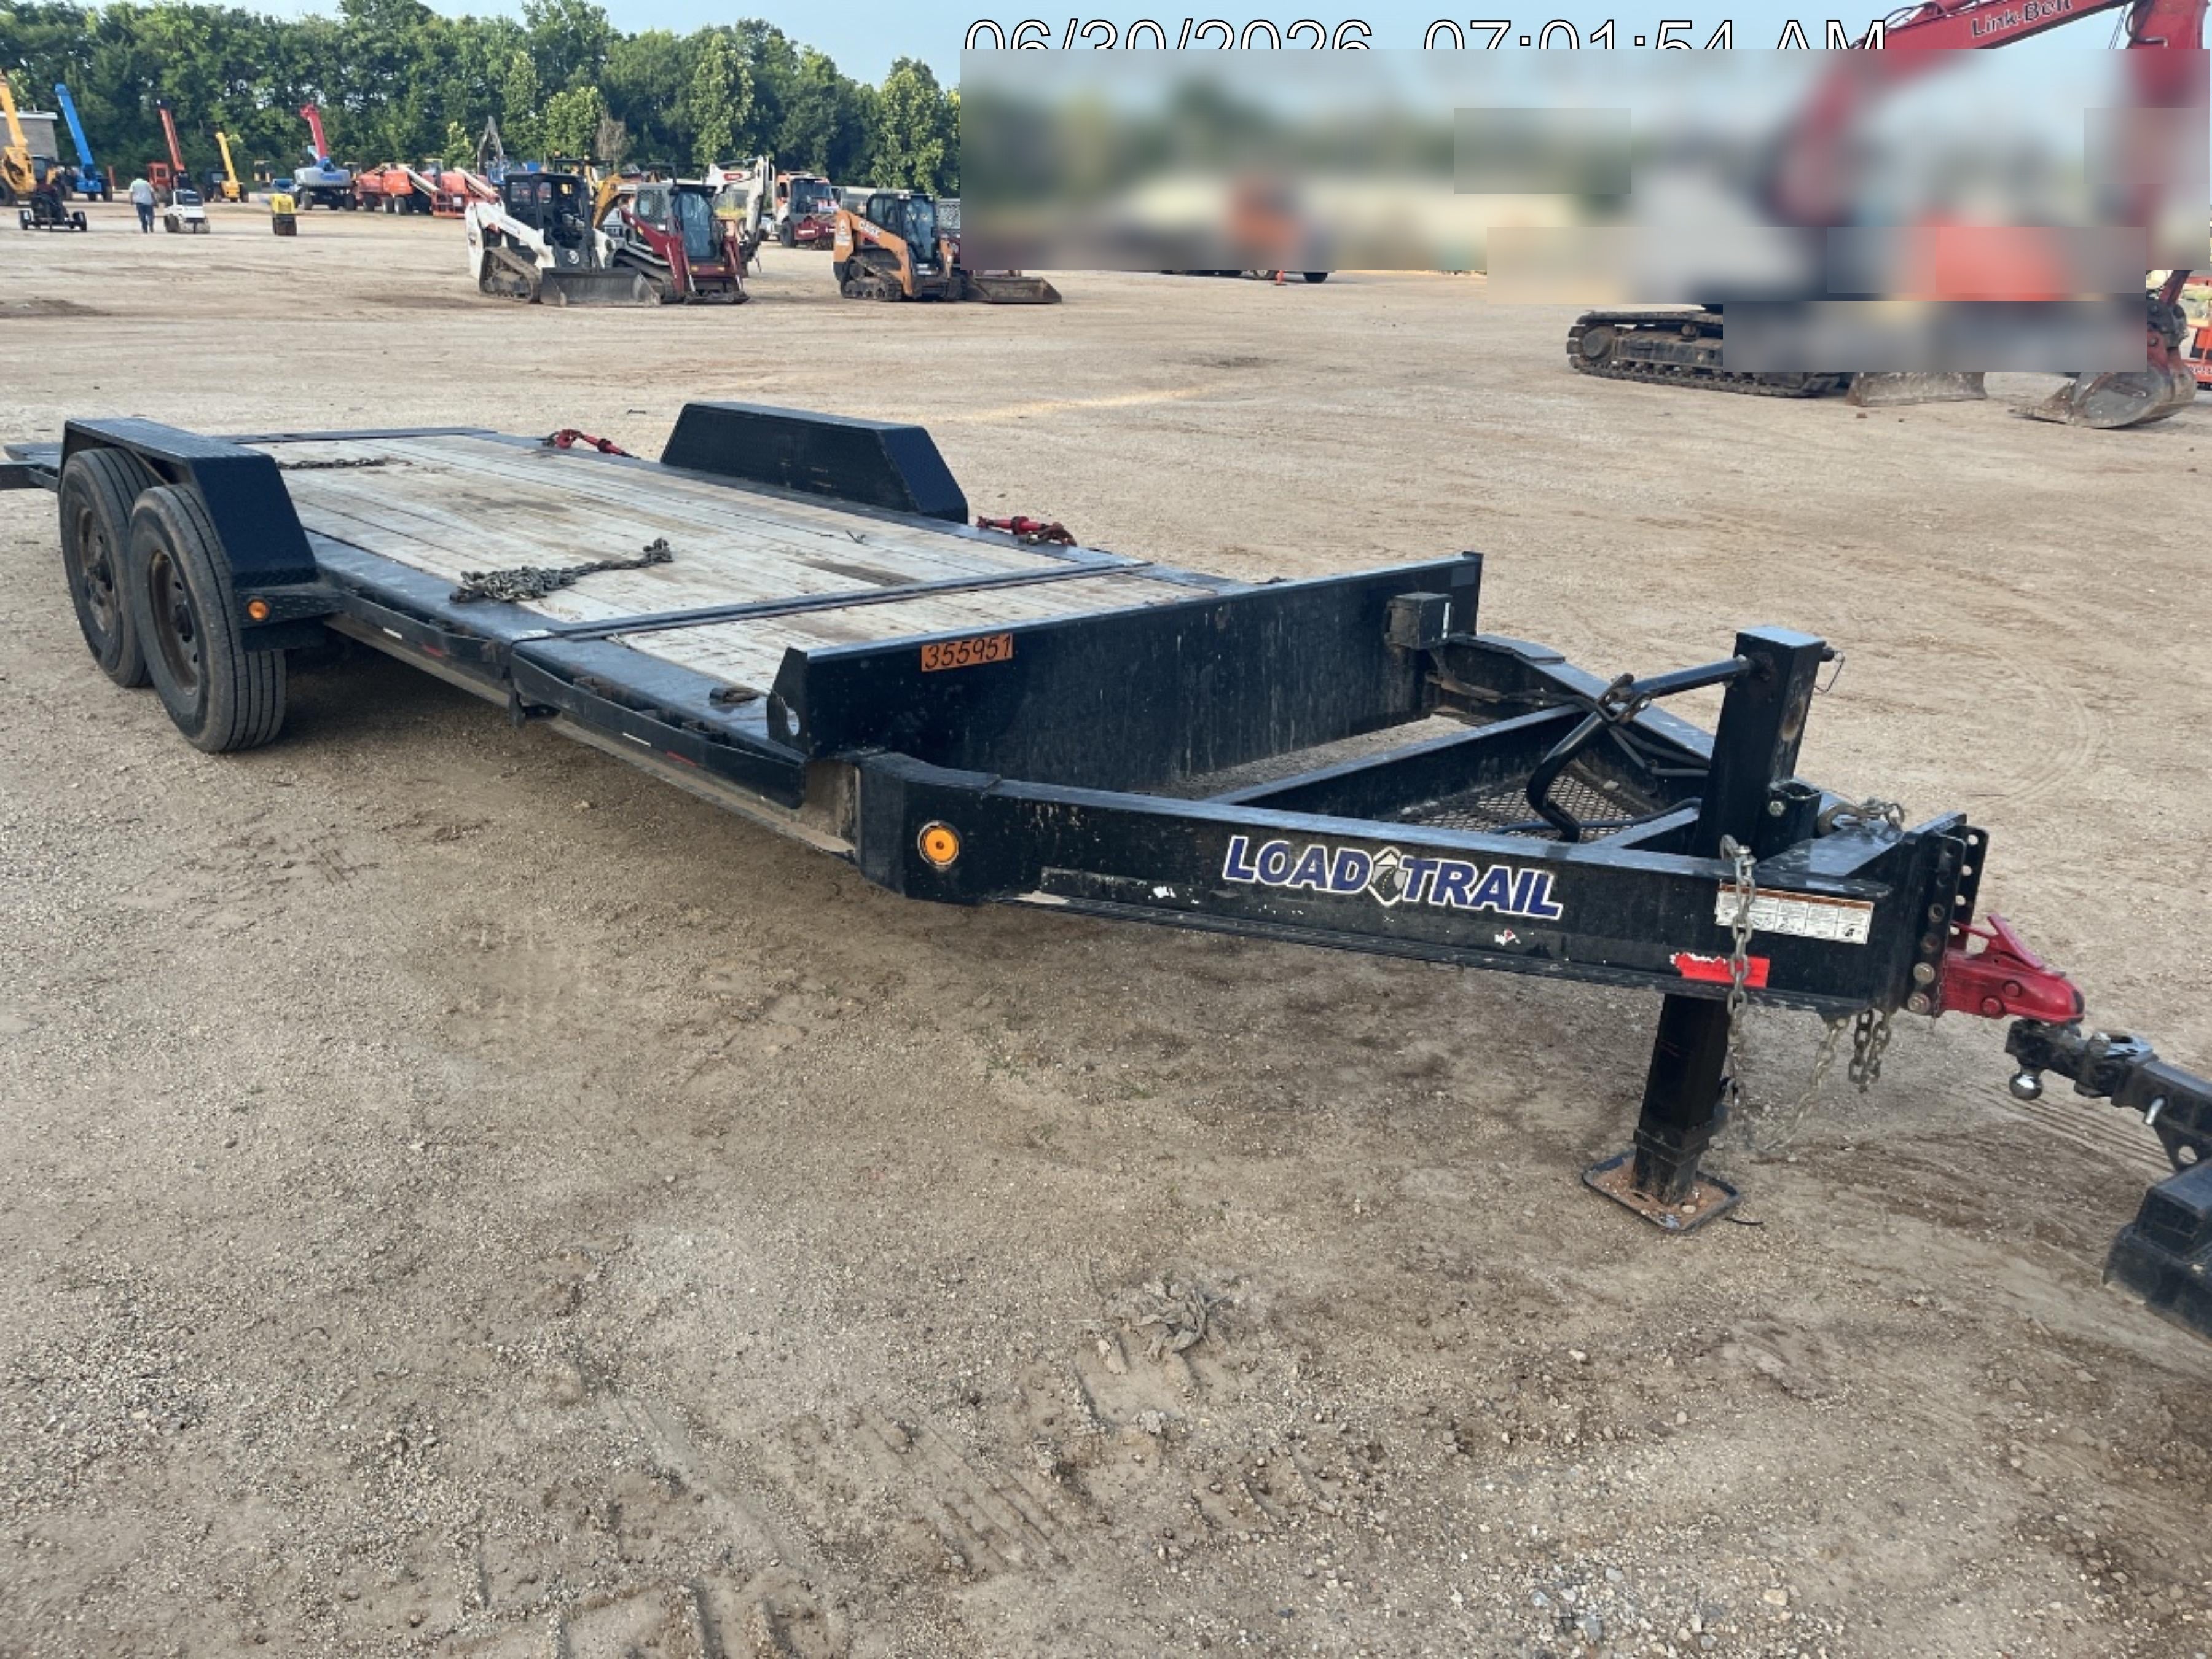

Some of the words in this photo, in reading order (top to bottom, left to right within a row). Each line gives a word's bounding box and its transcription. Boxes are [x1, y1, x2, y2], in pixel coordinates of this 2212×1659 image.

[925, 634, 1011, 669] 355951
[1222, 836, 1375, 895] LOAD
[1402, 856, 1563, 919] TRAIL
